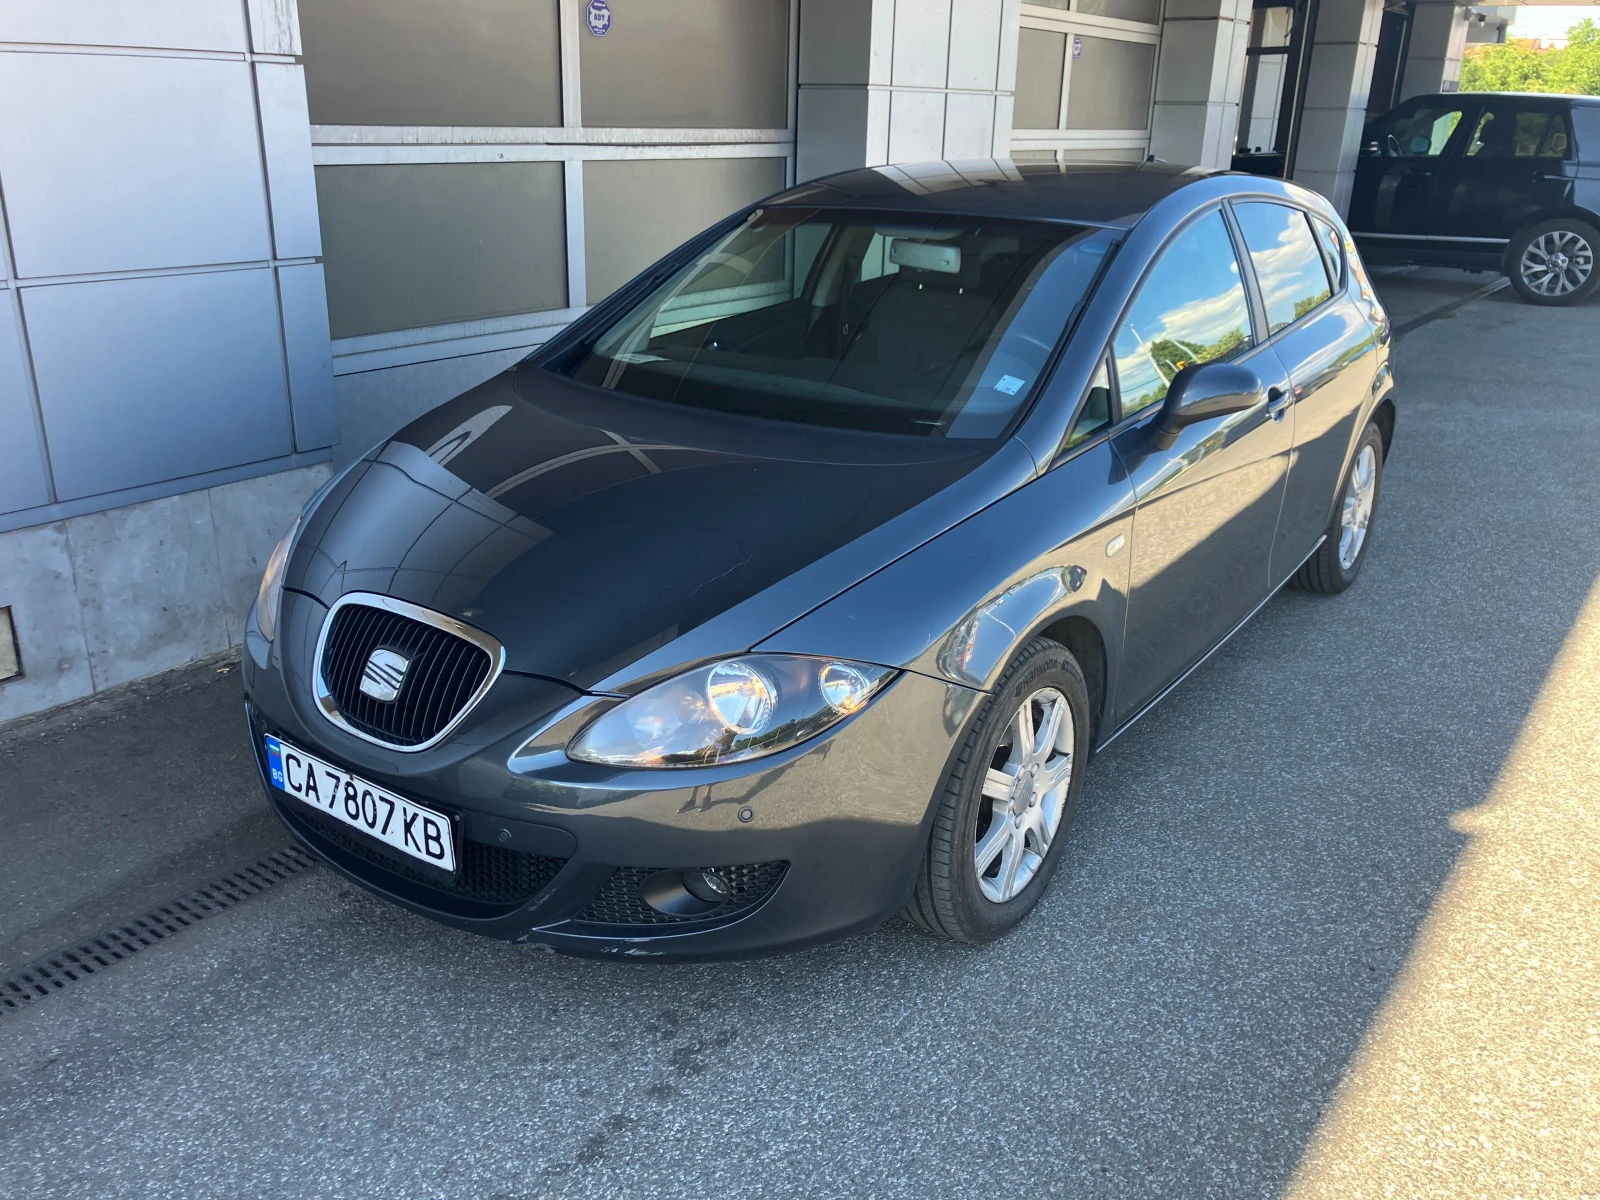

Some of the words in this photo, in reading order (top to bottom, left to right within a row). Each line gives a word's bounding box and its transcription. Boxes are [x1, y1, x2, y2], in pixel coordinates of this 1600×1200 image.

[593, 13, 605, 22] ADT
[272, 767, 283, 783] BG
[285, 753, 321, 804] CA
[324, 770, 396, 836] 7807
[402, 806, 445, 860] KB
